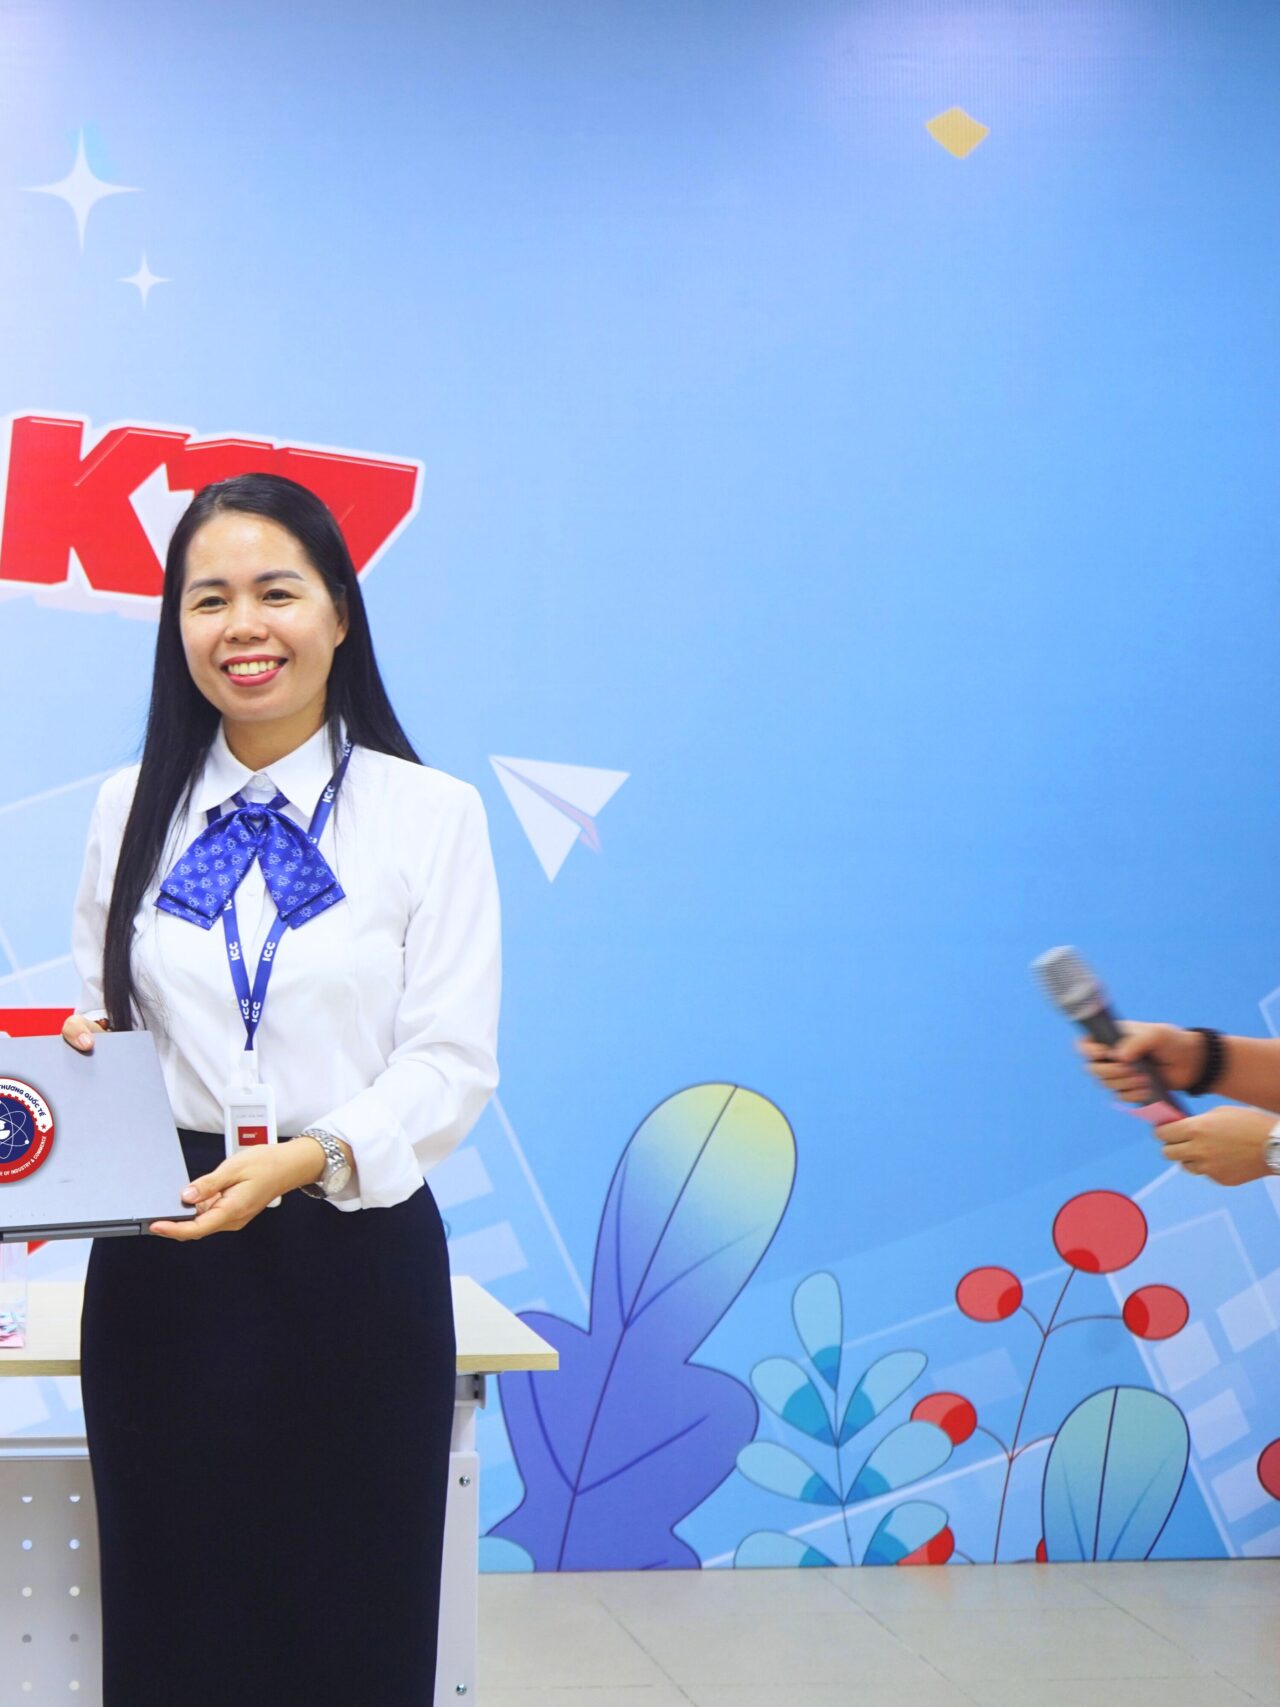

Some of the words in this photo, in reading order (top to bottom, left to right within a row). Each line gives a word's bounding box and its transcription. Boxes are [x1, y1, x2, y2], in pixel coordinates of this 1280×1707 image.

[322, 785, 335, 803] ICC
[229, 941, 240, 961] ICC
[262, 941, 275, 962] ICC
[241, 999, 249, 1019] ICC
[252, 1001, 261, 1022] ICC
